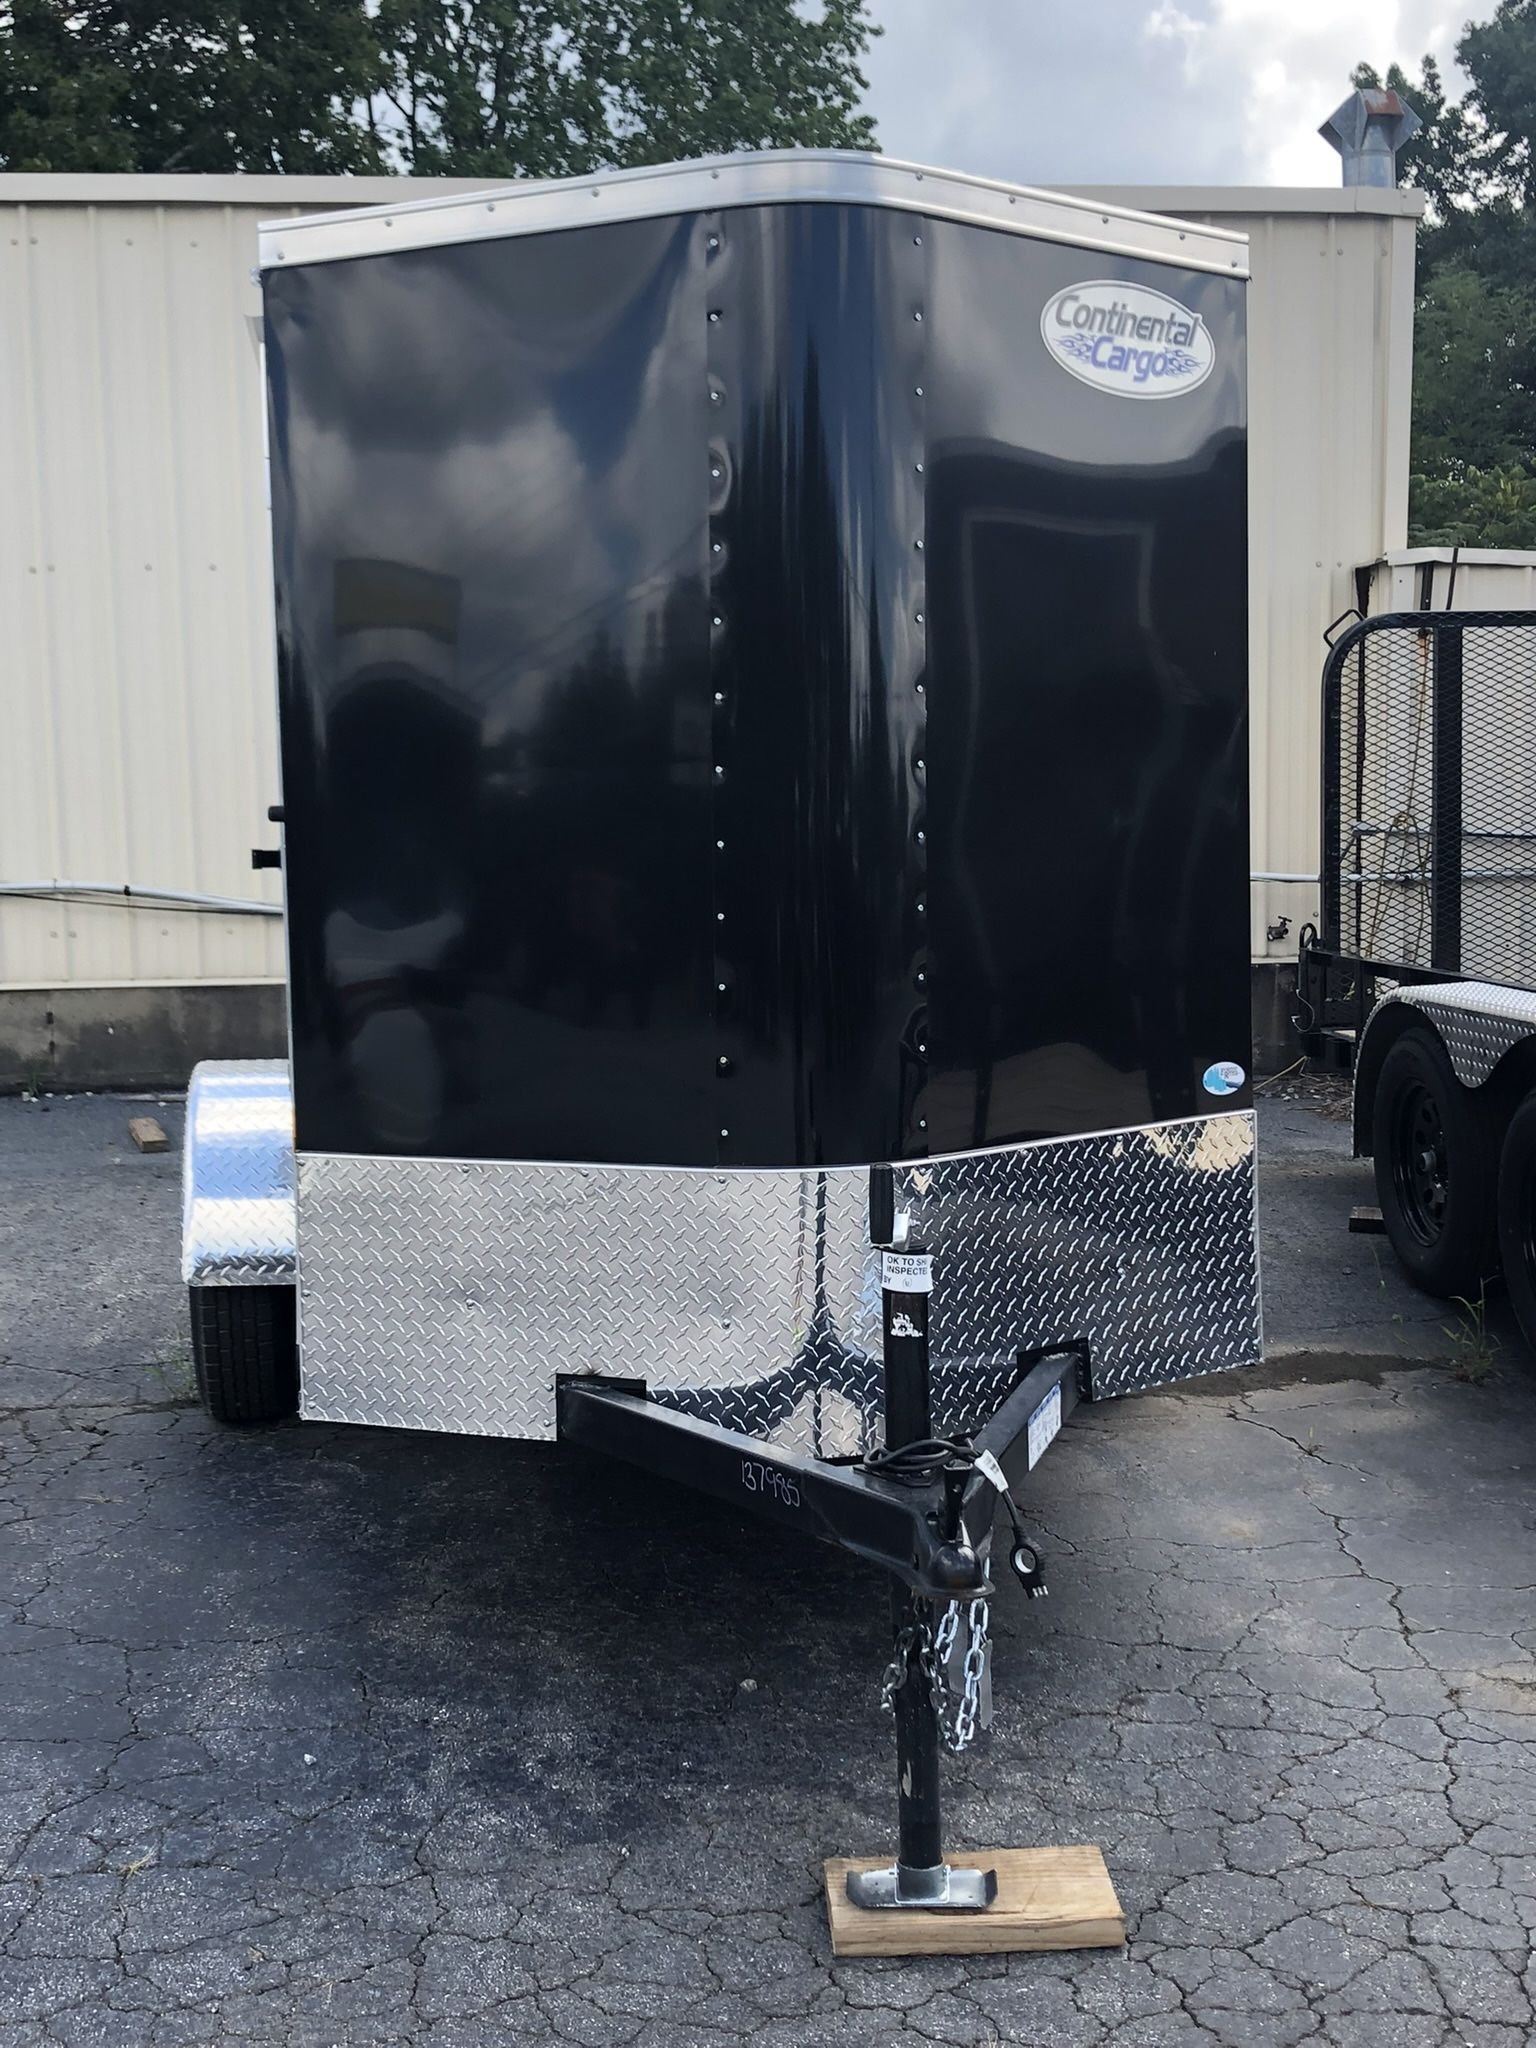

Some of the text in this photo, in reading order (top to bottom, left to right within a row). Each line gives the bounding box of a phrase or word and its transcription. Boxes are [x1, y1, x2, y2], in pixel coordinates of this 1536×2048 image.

[1055, 294, 1200, 348] Continental
[1090, 335, 1169, 382] Cargo
[887, 1255, 899, 1265] OK
[902, 1257, 914, 1266] TO
